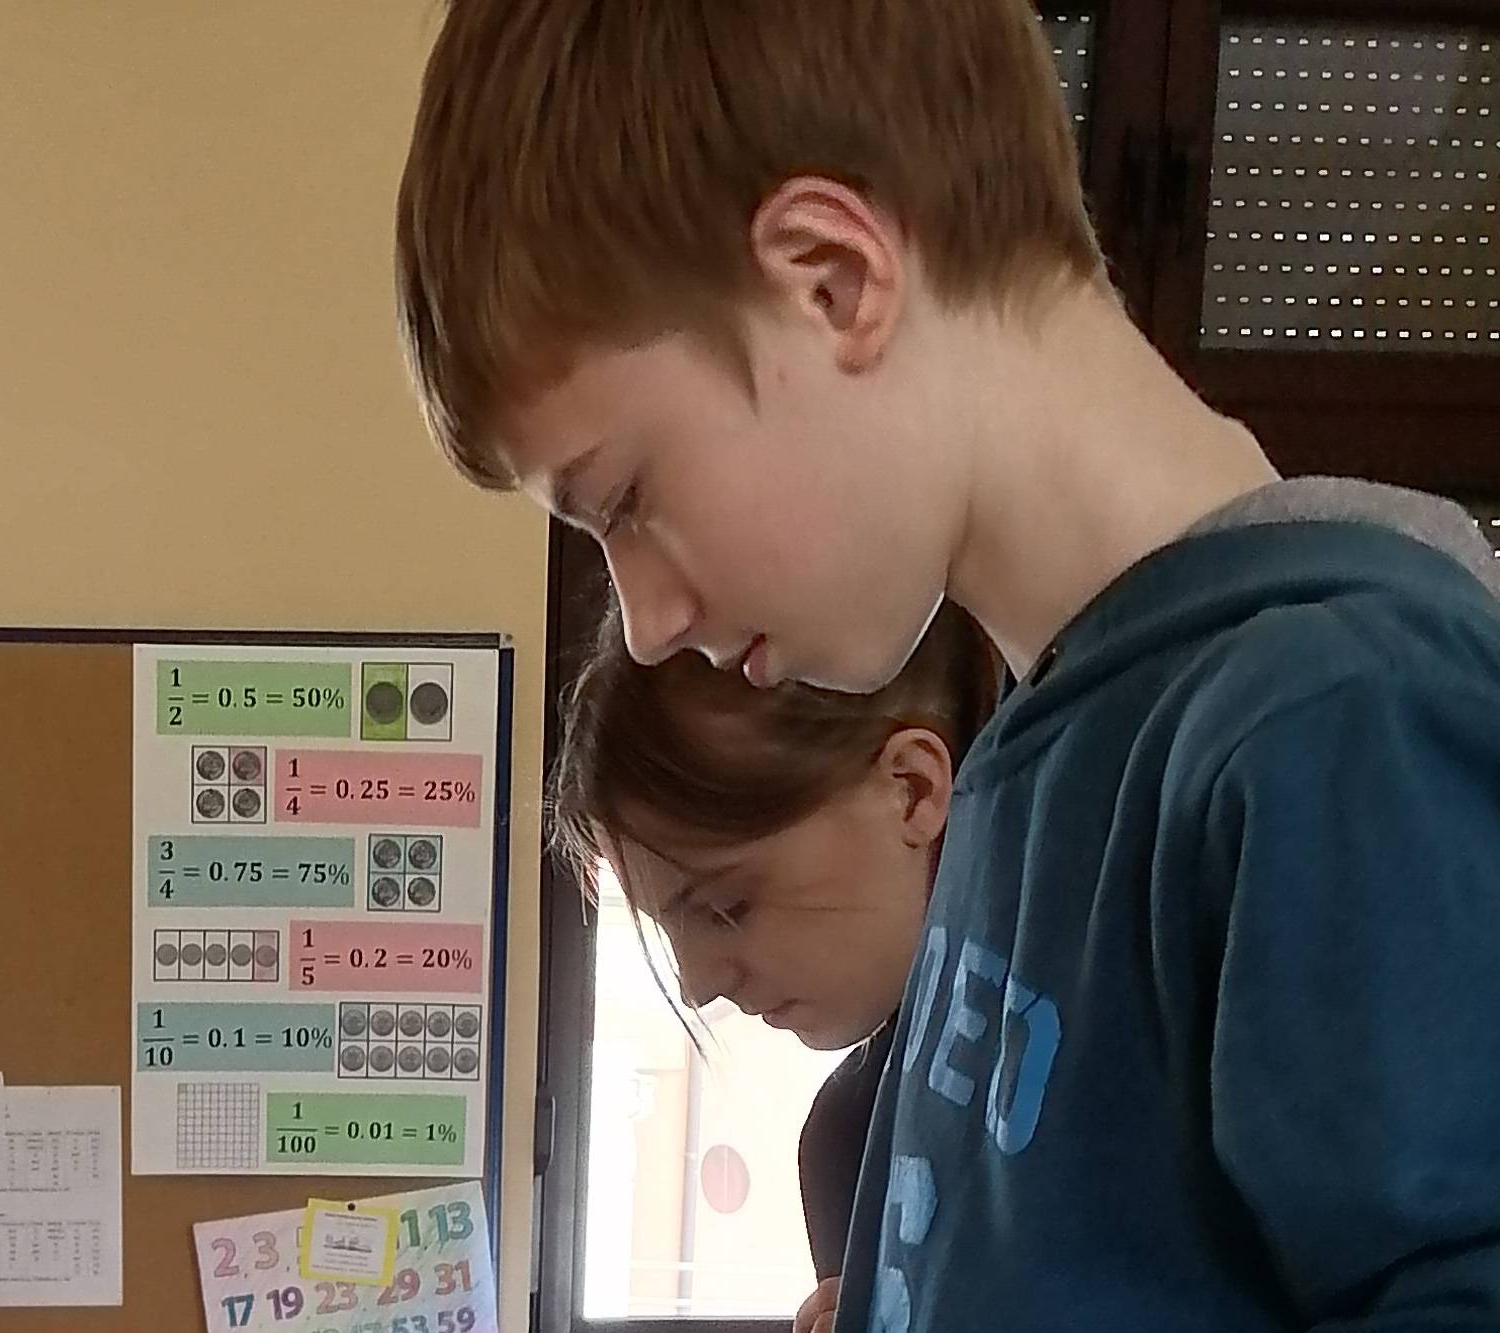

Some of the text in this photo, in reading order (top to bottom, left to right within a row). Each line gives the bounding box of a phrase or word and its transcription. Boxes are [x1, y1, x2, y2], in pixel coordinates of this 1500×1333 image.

[218, 687, 257, 708] 0.5
[292, 687, 345, 709] 50%
[336, 779, 390, 800] 0.25
[424, 780, 476, 802] 25%
[209, 862, 263, 882] 0.75
[298, 863, 350, 885] 75%
[349, 948, 388, 969] 0.2
[422, 948, 473, 970] 20%
[208, 1028, 246, 1048] 0.1
[282, 1028, 333, 1048] 10%
[347, 1121, 394, 1140] 0.01
[426, 1123, 457, 1143] 1%
